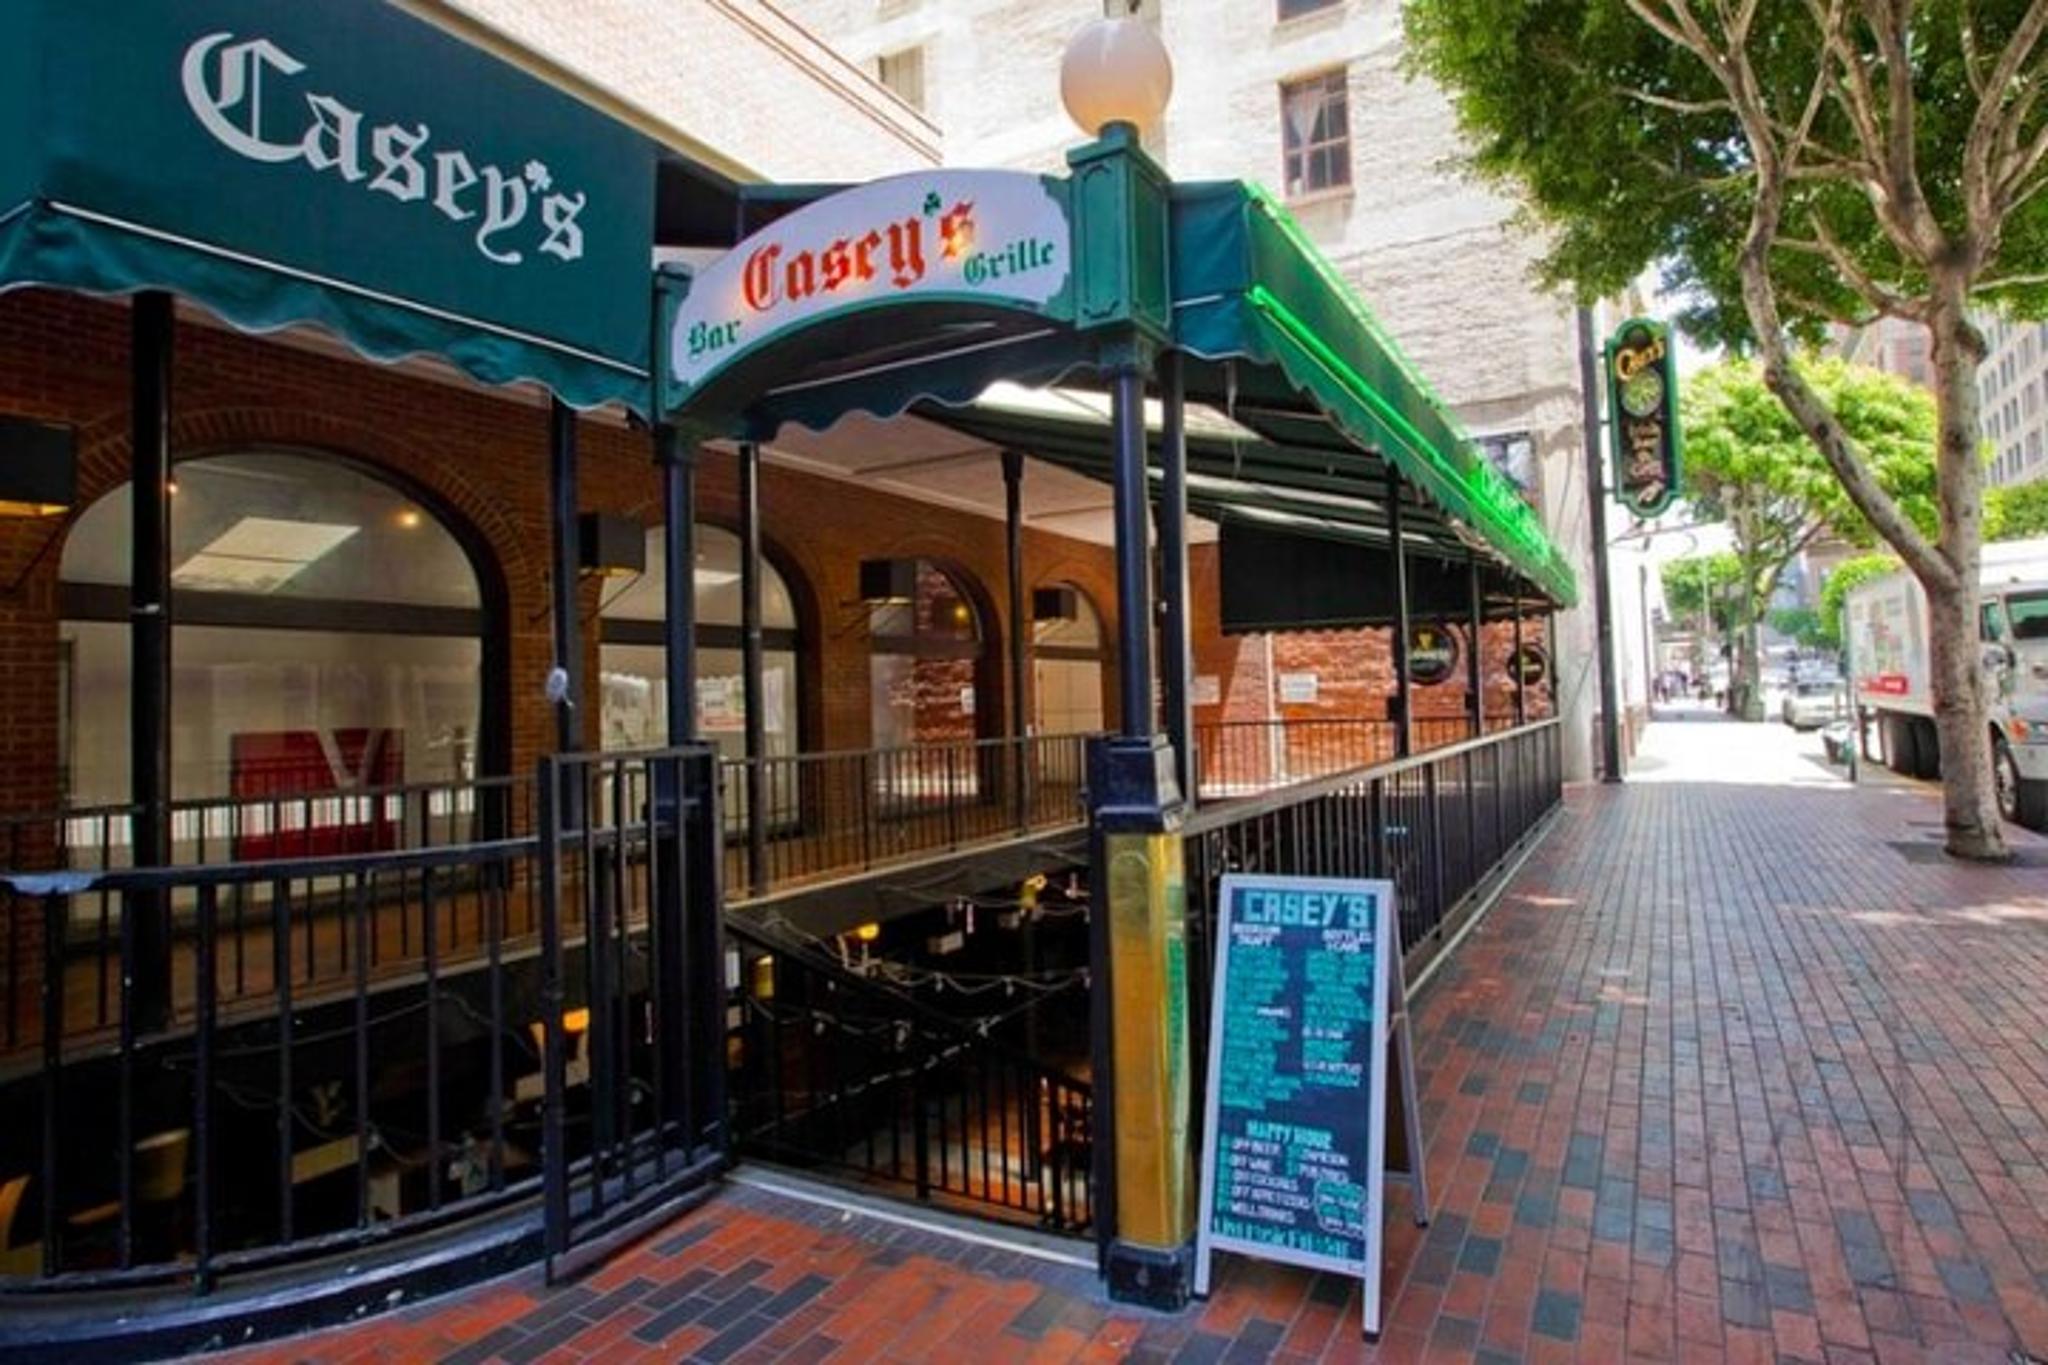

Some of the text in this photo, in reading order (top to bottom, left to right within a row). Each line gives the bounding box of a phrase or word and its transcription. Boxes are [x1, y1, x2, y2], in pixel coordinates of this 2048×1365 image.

[181, 32, 587, 265] Casey's
[742, 200, 976, 312] Casey's
[963, 237, 1055, 287] Grille
[688, 318, 740, 356] Bar
[1243, 891, 1370, 928] CASEY'S
